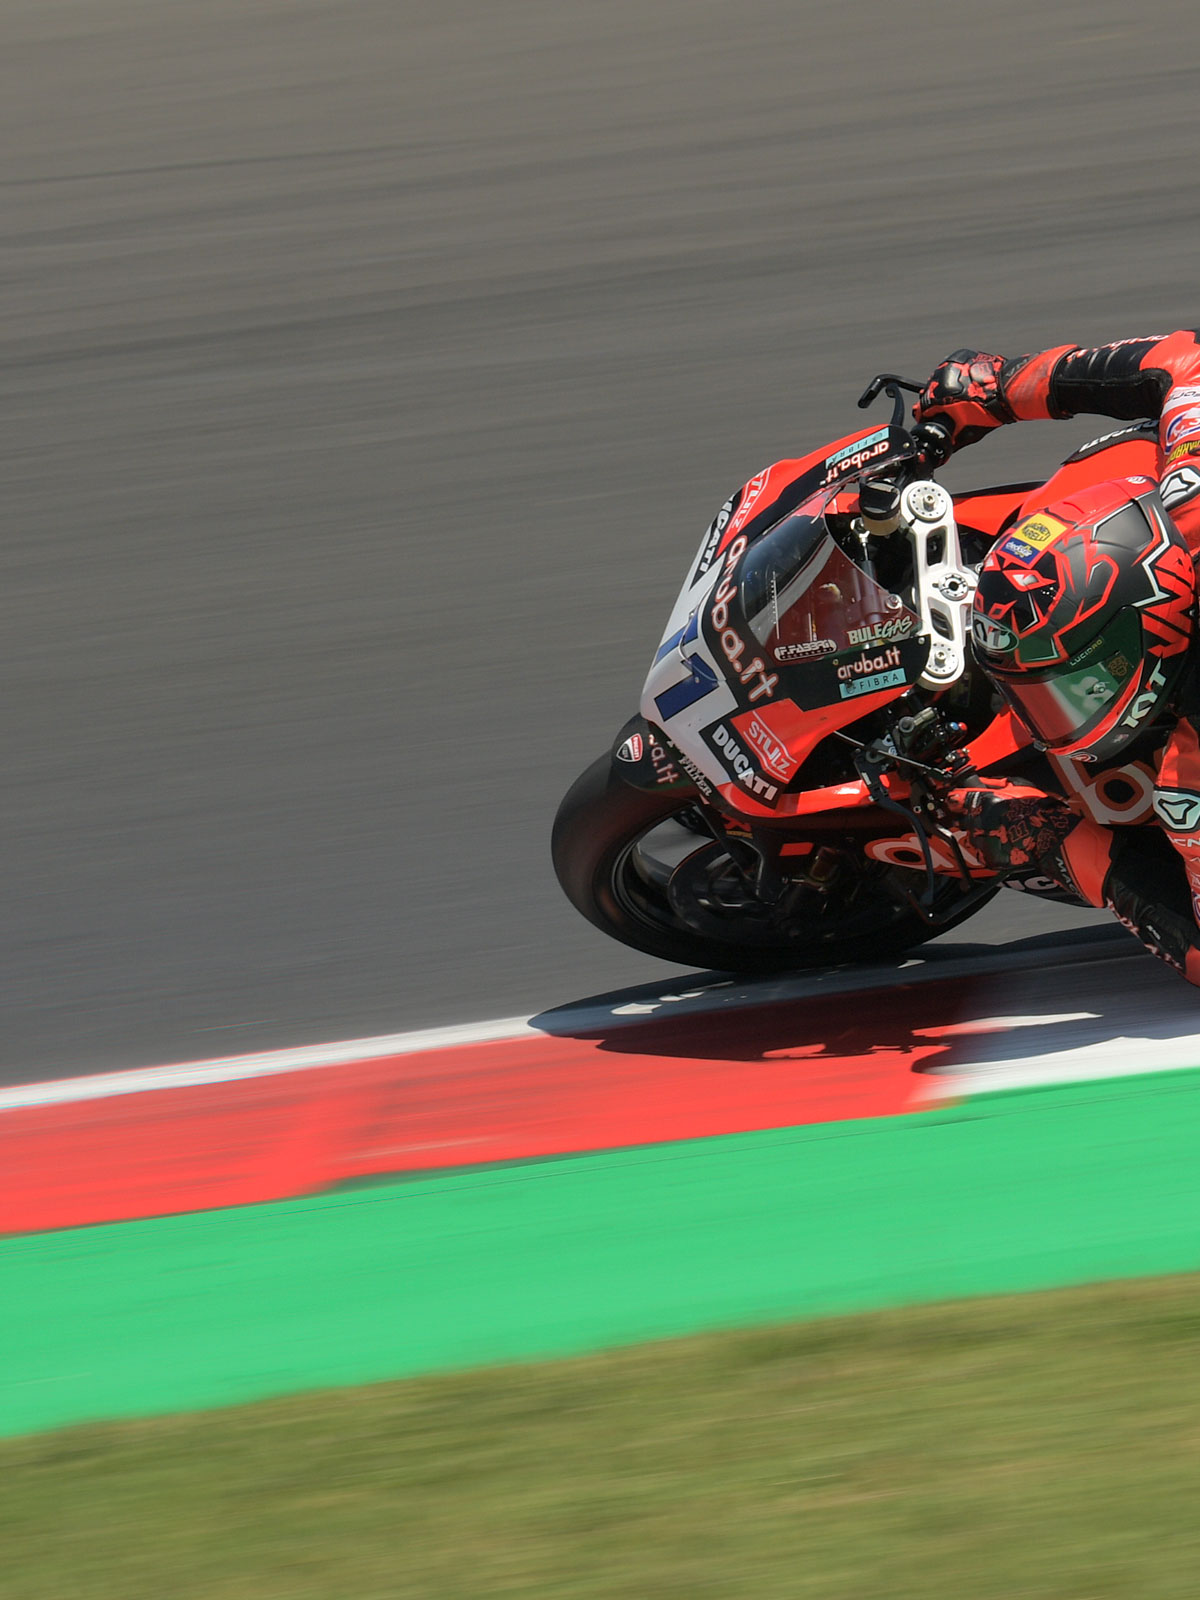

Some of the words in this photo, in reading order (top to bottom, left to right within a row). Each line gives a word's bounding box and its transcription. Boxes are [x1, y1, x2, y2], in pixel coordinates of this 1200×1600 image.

[825, 440, 890, 483] aruba.it
[710, 535, 779, 702] aruba.it
[847, 615, 913, 645] BULEGAS
[837, 645, 901, 680] aruba.it
[860, 673, 899, 691] FIBRA
[711, 723, 779, 801] DUCATI
[749, 720, 791, 776] STULZ
